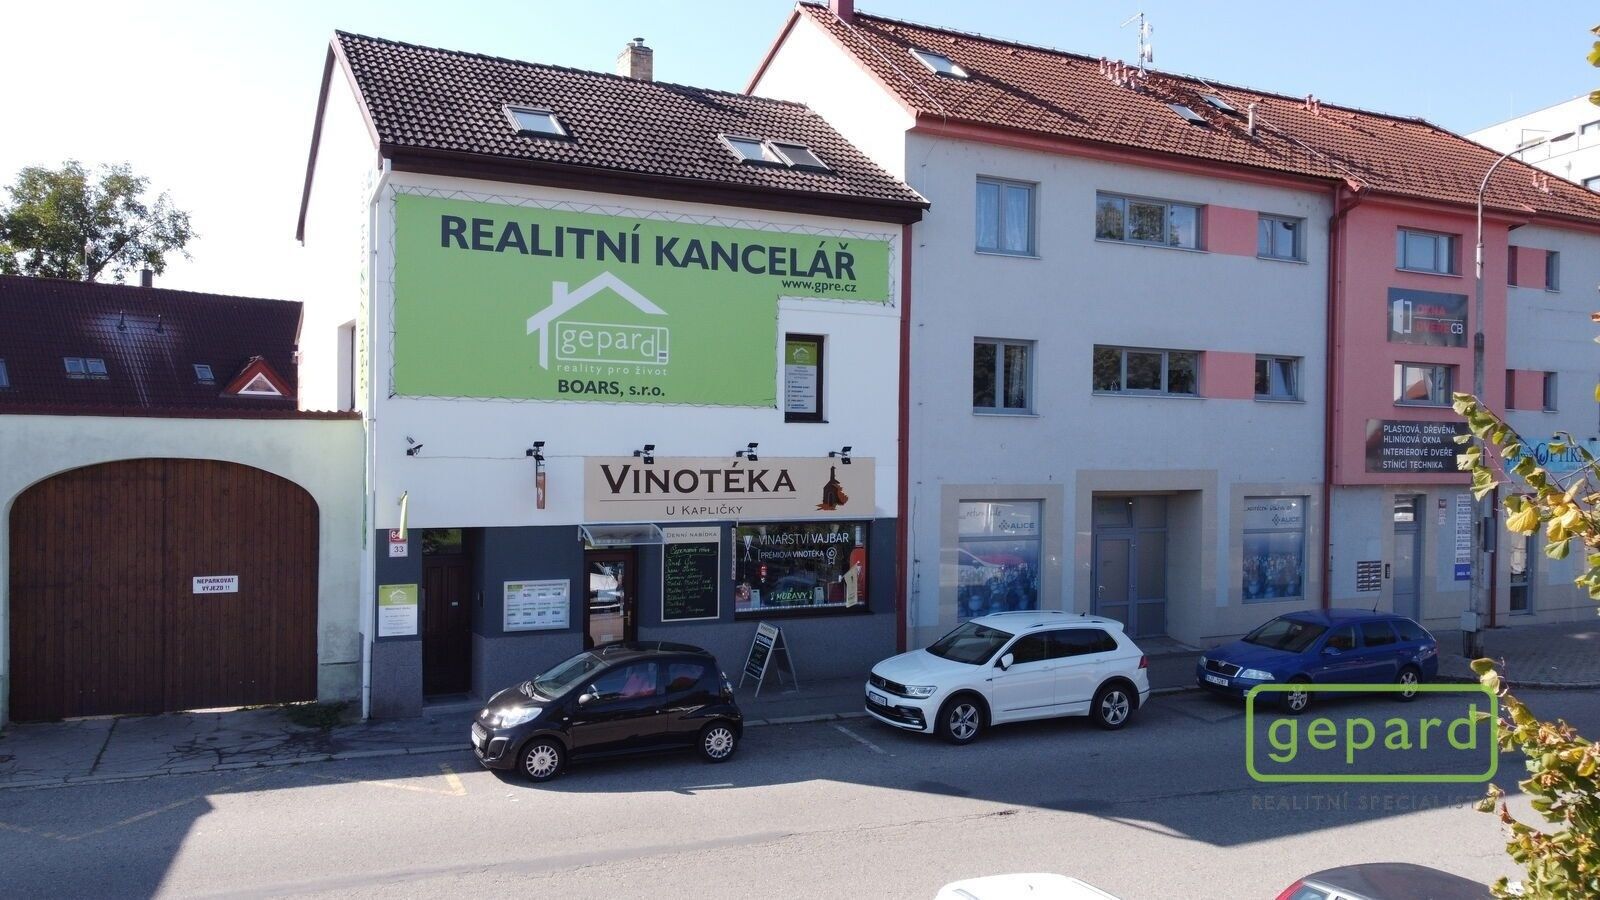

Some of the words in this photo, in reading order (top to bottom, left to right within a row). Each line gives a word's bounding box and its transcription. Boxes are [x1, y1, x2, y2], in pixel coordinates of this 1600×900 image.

[441, 214, 641, 264] REALITNÍ
[655, 236, 857, 281] KANCELÁŘ
[781, 279, 857, 293] www.gpre.cz
[561, 329, 655, 357] gepard
[557, 363, 602, 375] reality
[608, 366, 630, 376] pro
[635, 365, 667, 376] život
[558, 379, 624, 397] BOARS,
[629, 384, 665, 397] s.r.o.
[1383, 435, 1420, 444] HLINÍKOVÁ
[1422, 436, 1441, 444] OKNA
[1430, 448, 1453, 457] DVEŘE
[1410, 460, 1443, 469] TECHNIKA
[666, 506, 675, 516] U
[758, 531, 810, 545] VINAŘSTVÍ
[811, 532, 849, 544] VAJBAR
[792, 550, 824, 558] VINOTÉKA
